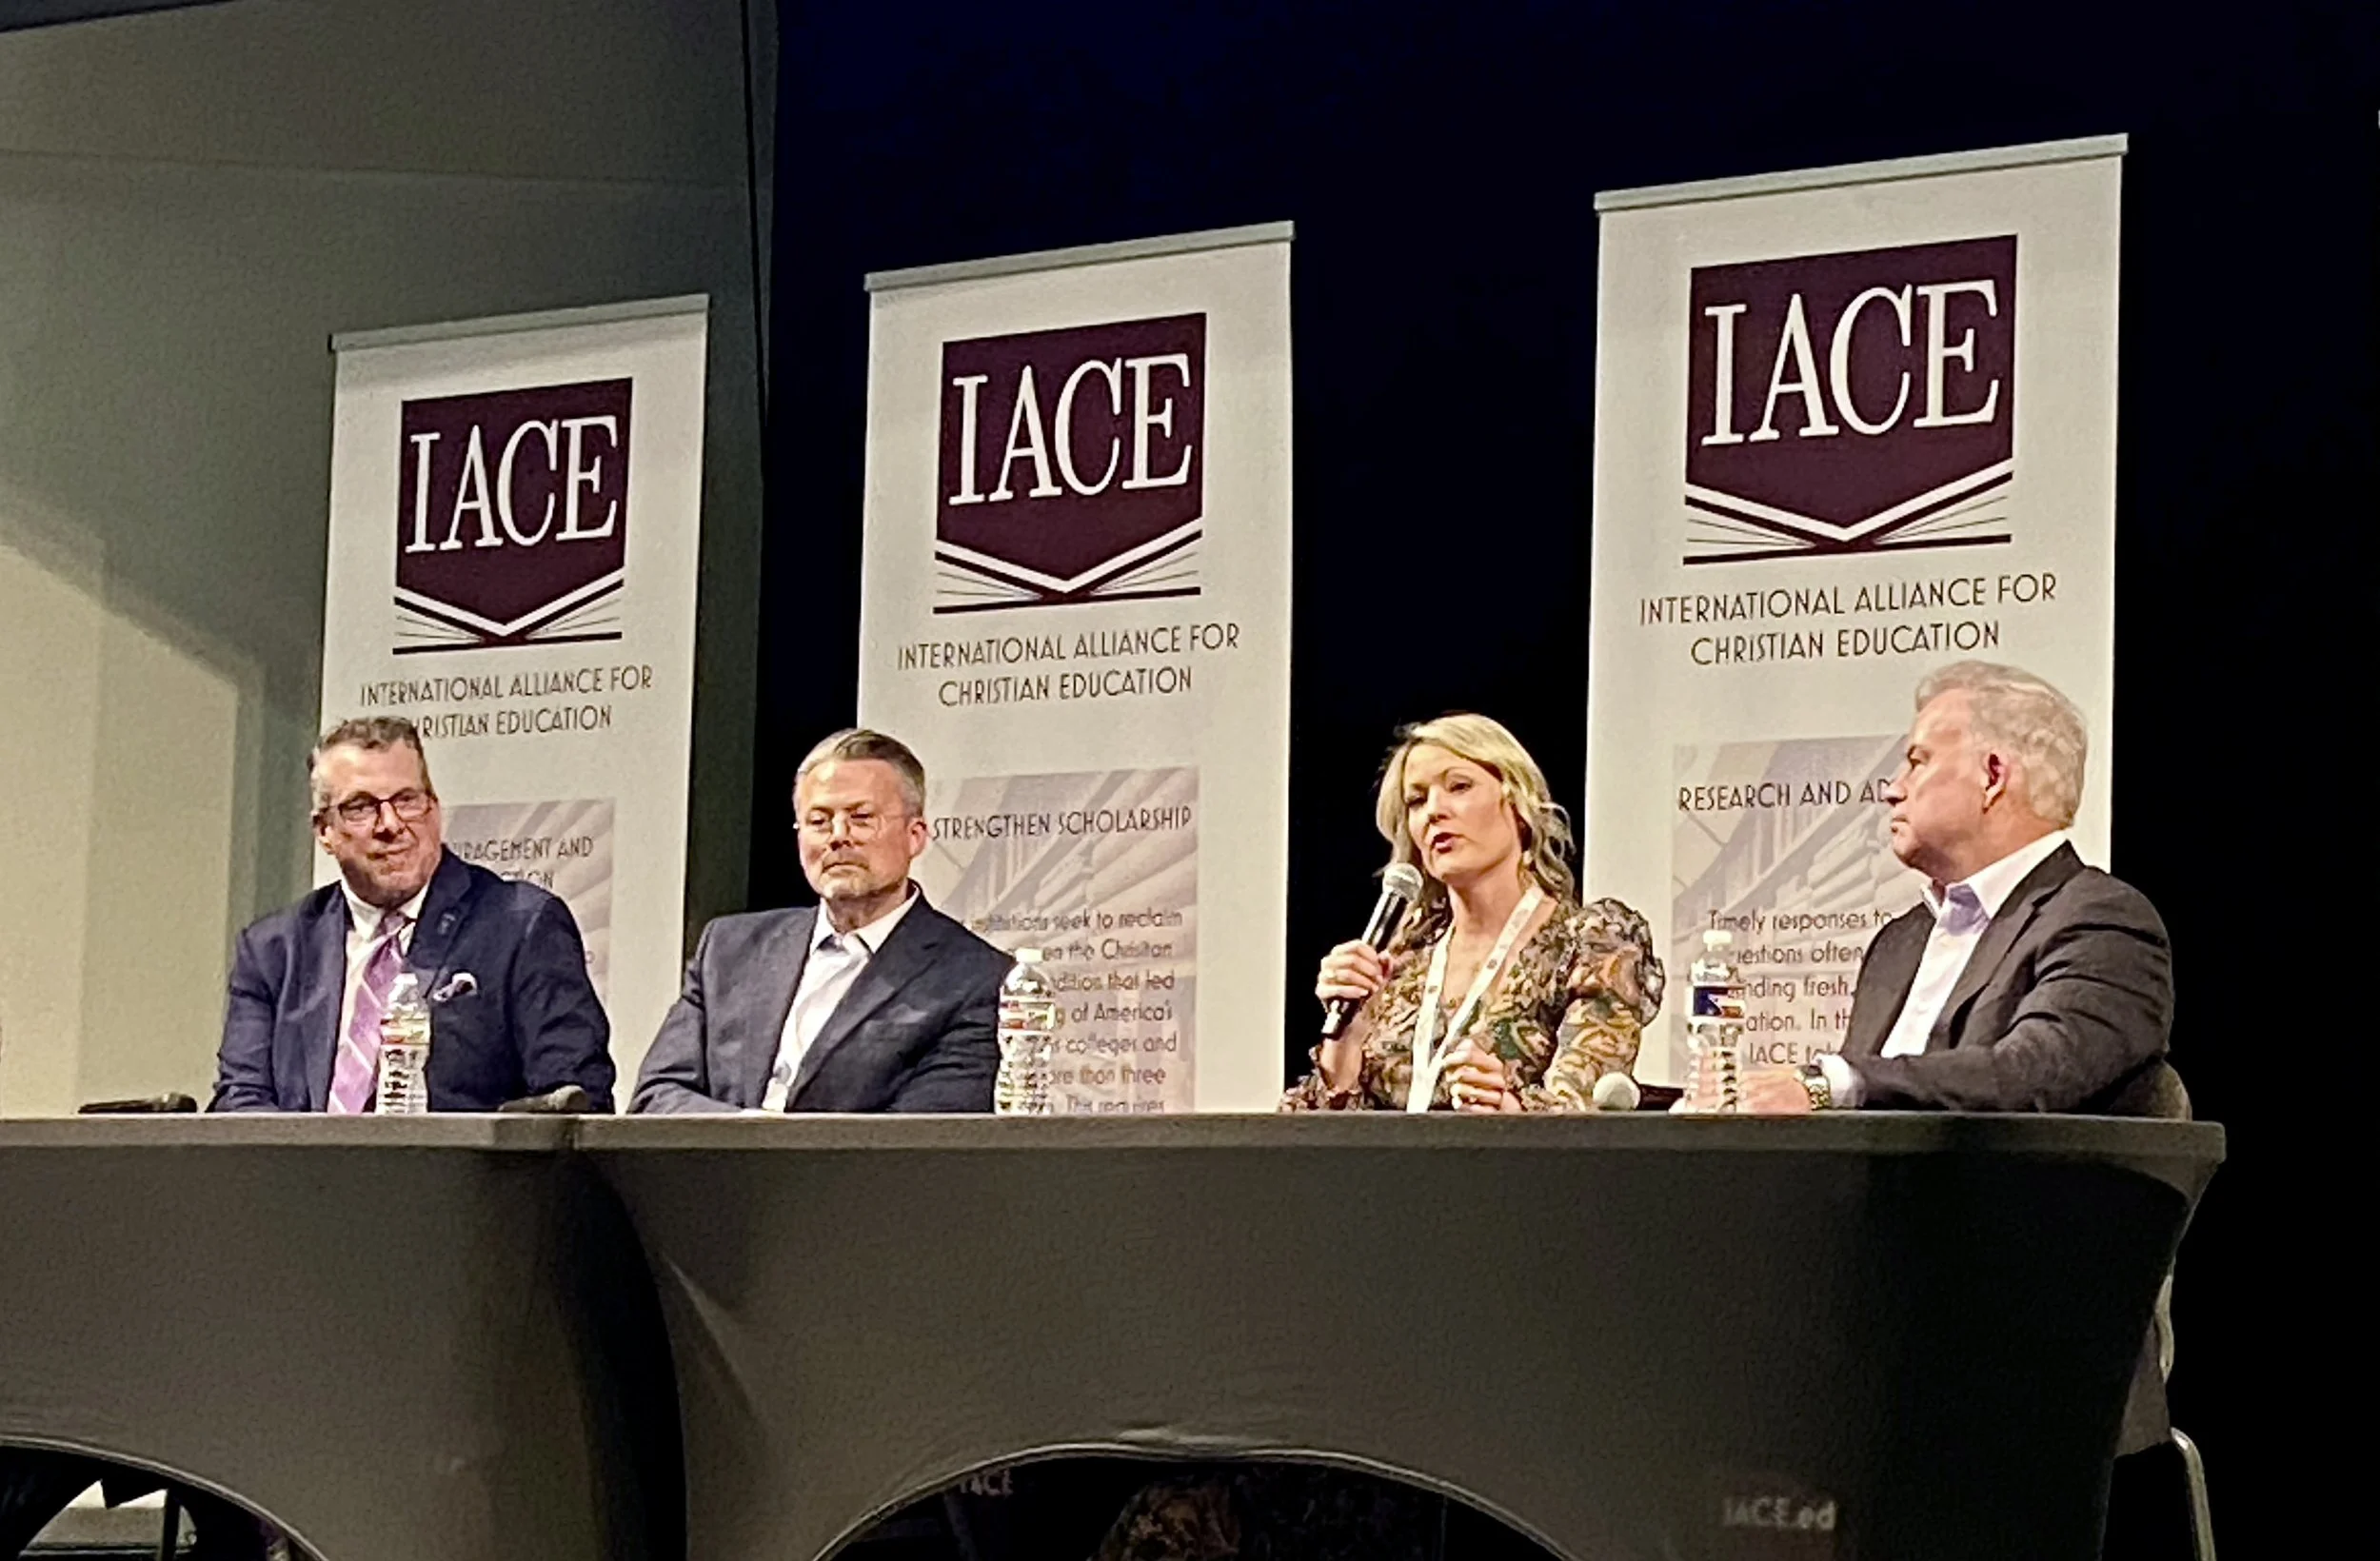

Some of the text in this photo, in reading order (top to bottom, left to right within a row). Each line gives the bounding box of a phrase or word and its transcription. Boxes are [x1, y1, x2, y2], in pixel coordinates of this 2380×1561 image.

[1701, 279, 1998, 446] IACE
[949, 353, 1192, 505] IACE
[406, 414, 618, 554] IACE
[1639, 572, 2057, 626] INTERNATIONAL ALLIANCE FOR
[898, 622, 1240, 670] INTERNATIONAL ALLIANCE FOR
[1691, 621, 1999, 665] CHRISTIAN EDUCATION
[361, 664, 653, 707] INTERNATIONAL ALLIANCE FOR
[939, 666, 1192, 707] CHRISTIAN EDUCATION
[415, 704, 612, 739] RISTIAN EDUCATION
[1678, 782, 1791, 811] RESEARCH
[1800, 780, 1852, 806] AND
[932, 805, 1192, 841] STRENGTHEN SCHOLARSHIP
[453, 836, 594, 861] RAGEMENT AND
[1054, 908, 1091, 929] seek
[1097, 911, 1114, 929] to
[1119, 907, 1182, 928] reclaim
[1708, 909, 1767, 935] Timely
[1773, 910, 1868, 934] responses
[1736, 941, 1864, 964] estions often
[1745, 976, 1796, 1002] nding
[1746, 1008, 1801, 1032] ation.
[1811, 1008, 1827, 1029] In
[1143, 1031, 1178, 1053] and
[1750, 1042, 1797, 1064] IACE
